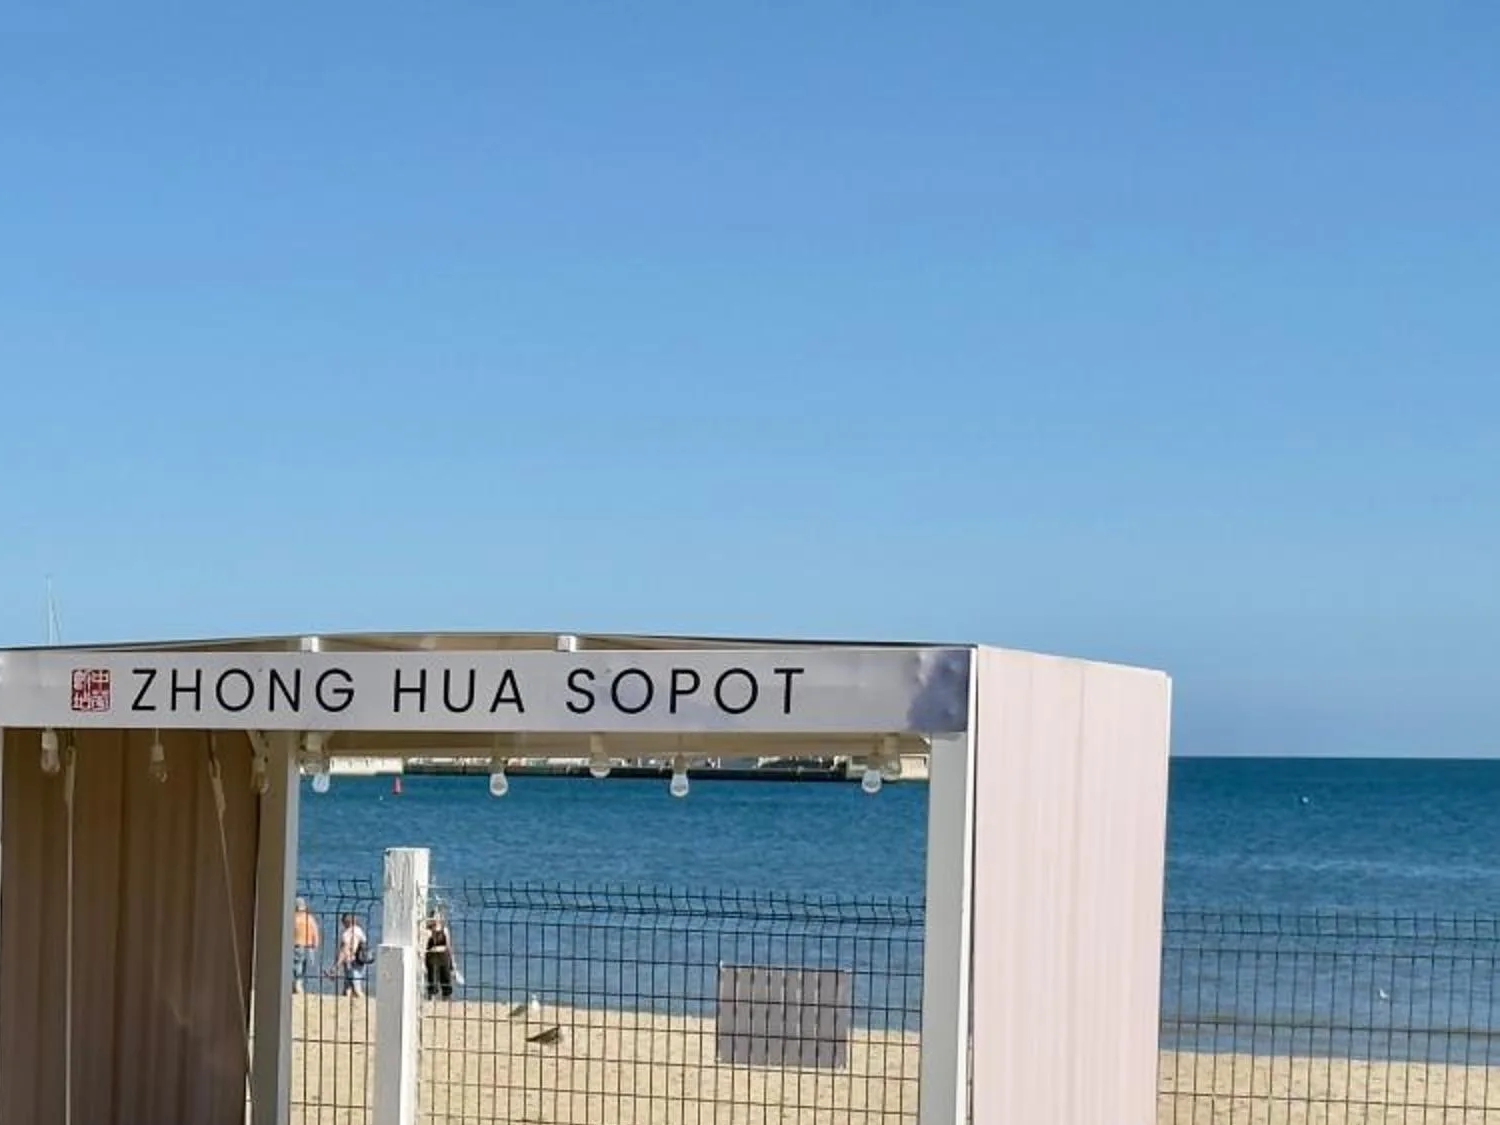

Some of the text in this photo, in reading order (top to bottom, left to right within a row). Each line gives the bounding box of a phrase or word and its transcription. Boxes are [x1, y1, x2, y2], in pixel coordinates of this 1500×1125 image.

[130, 667, 355, 713] ZHONG
[393, 668, 525, 713] HUA
[565, 667, 805, 715] SOPOT
